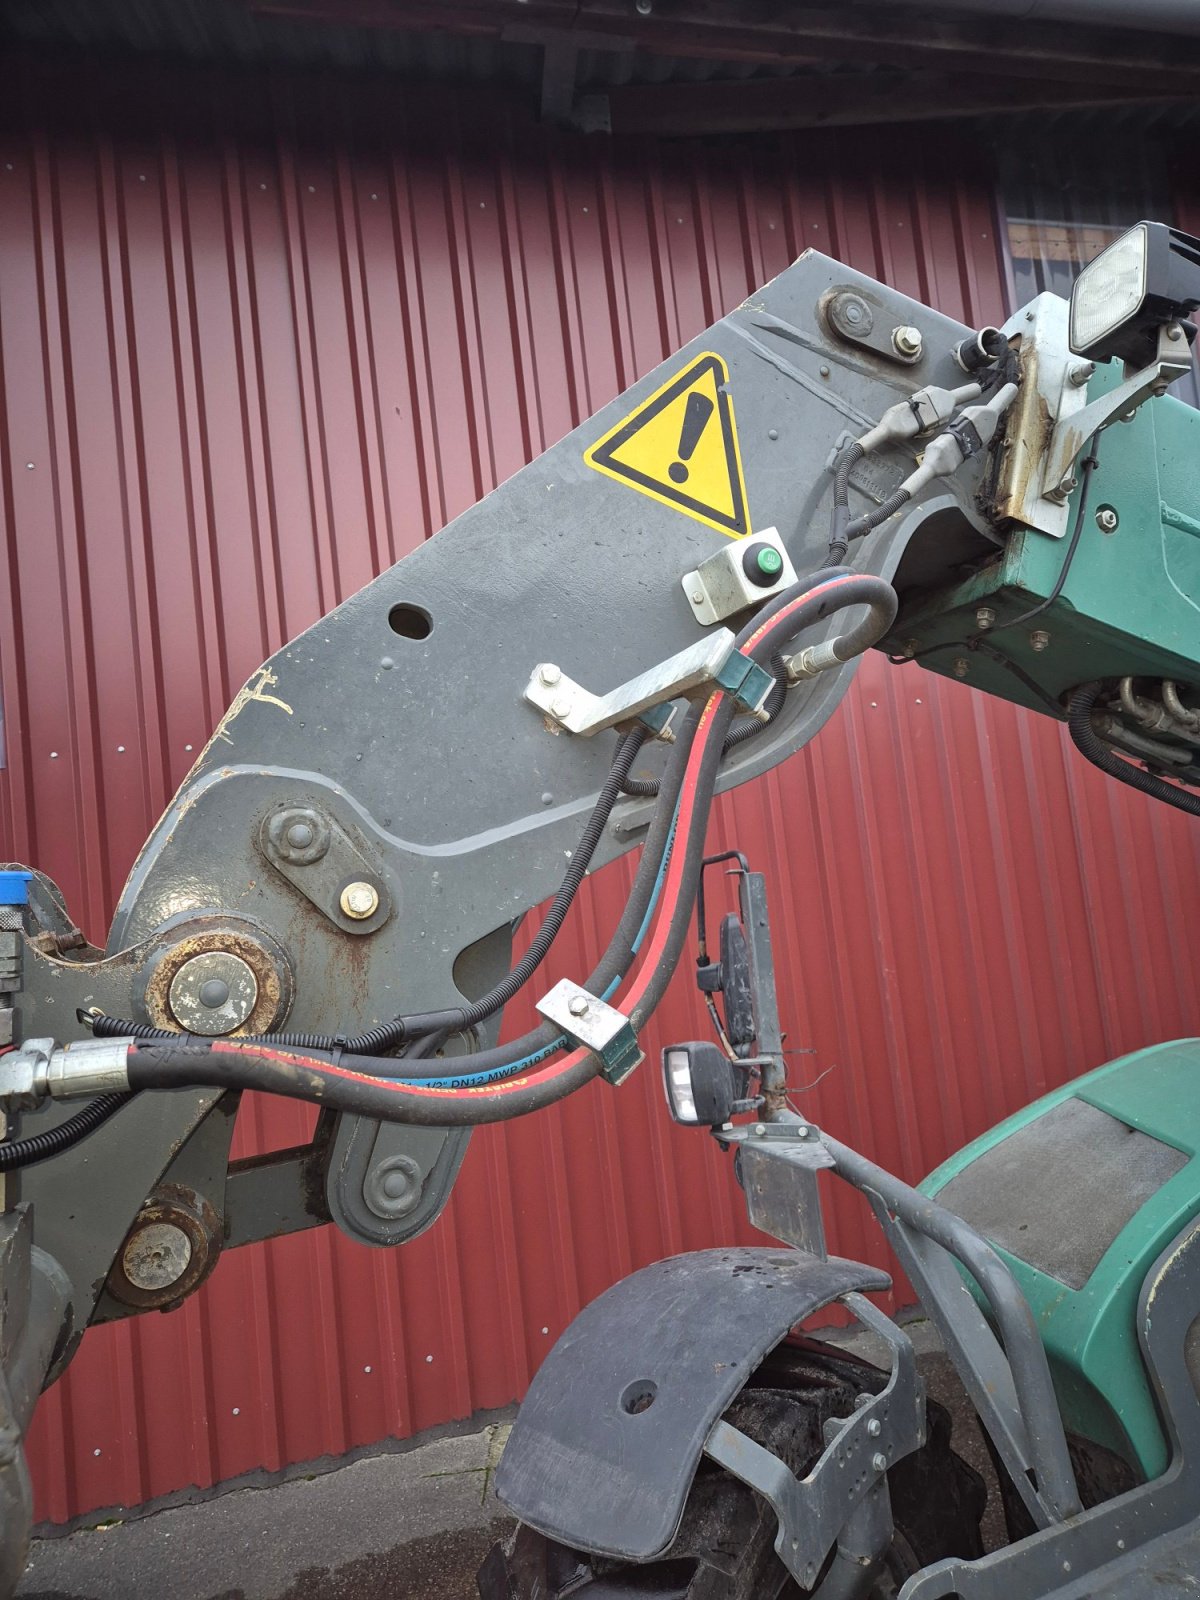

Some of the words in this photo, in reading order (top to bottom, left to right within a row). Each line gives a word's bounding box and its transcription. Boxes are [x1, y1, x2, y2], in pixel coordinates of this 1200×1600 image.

[451, 1076, 485, 1089] DN12
[488, 1066, 518, 1080] MWP
[522, 1055, 541, 1069] 310
